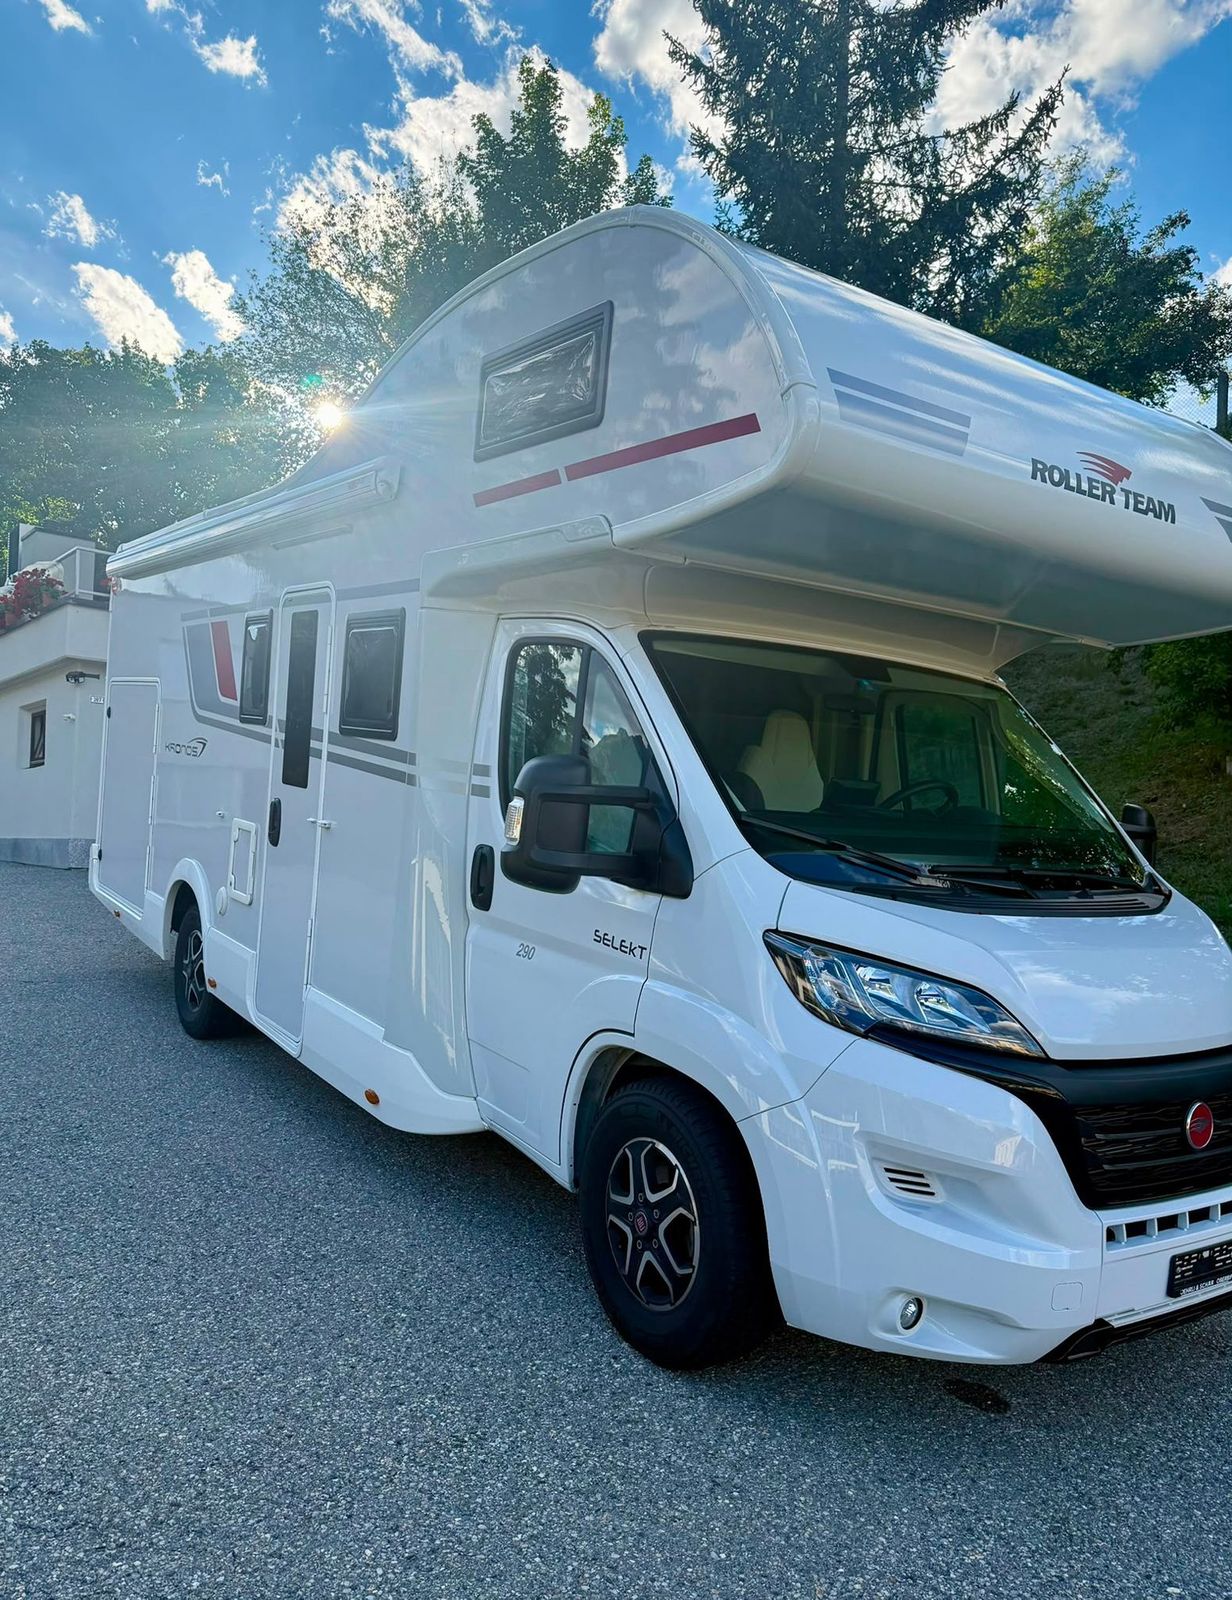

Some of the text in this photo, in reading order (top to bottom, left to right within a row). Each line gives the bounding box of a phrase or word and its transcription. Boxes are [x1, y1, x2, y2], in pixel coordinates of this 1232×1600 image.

[1030, 457, 1176, 525] ROLLER TEAM
[516, 942, 536, 961] 290
[593, 929, 648, 960] SELEKT
